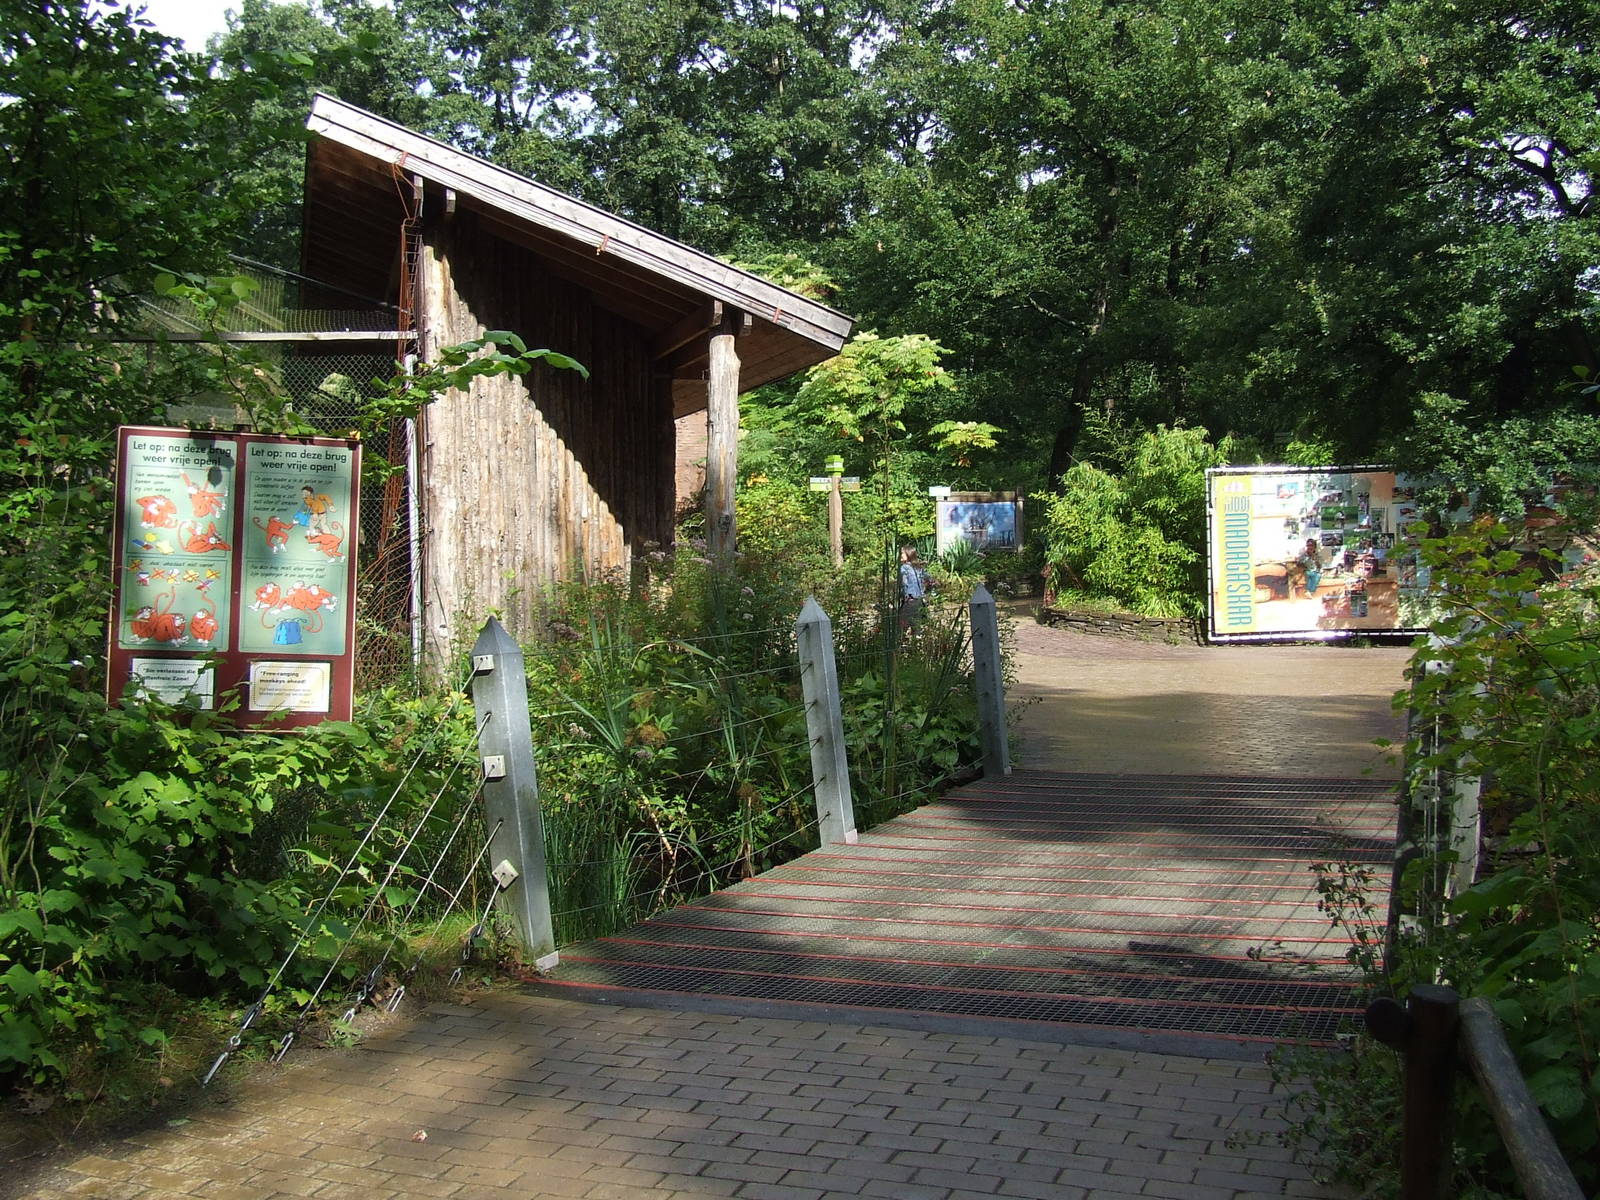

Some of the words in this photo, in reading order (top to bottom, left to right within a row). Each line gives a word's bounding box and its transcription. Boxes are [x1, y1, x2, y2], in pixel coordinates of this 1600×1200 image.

[133, 441, 146, 451] Let
[149, 444, 165, 454] op:
[168, 445, 181, 453] na
[183, 443, 207, 454] deze
[209, 445, 232, 457] brug
[251, 447, 264, 457] Let
[267, 449, 282, 460] op:
[285, 451, 297, 459] na
[300, 449, 323, 460] deze
[325, 451, 347, 463] brug
[143, 455, 167, 463] weer
[170, 454, 191, 466] vrije
[193, 457, 221, 467] apen!
[261, 461, 284, 469] weer
[287, 460, 308, 472] vrije
[310, 463, 337, 473] apen!
[1223, 512, 1253, 627] MADAGASKAR
